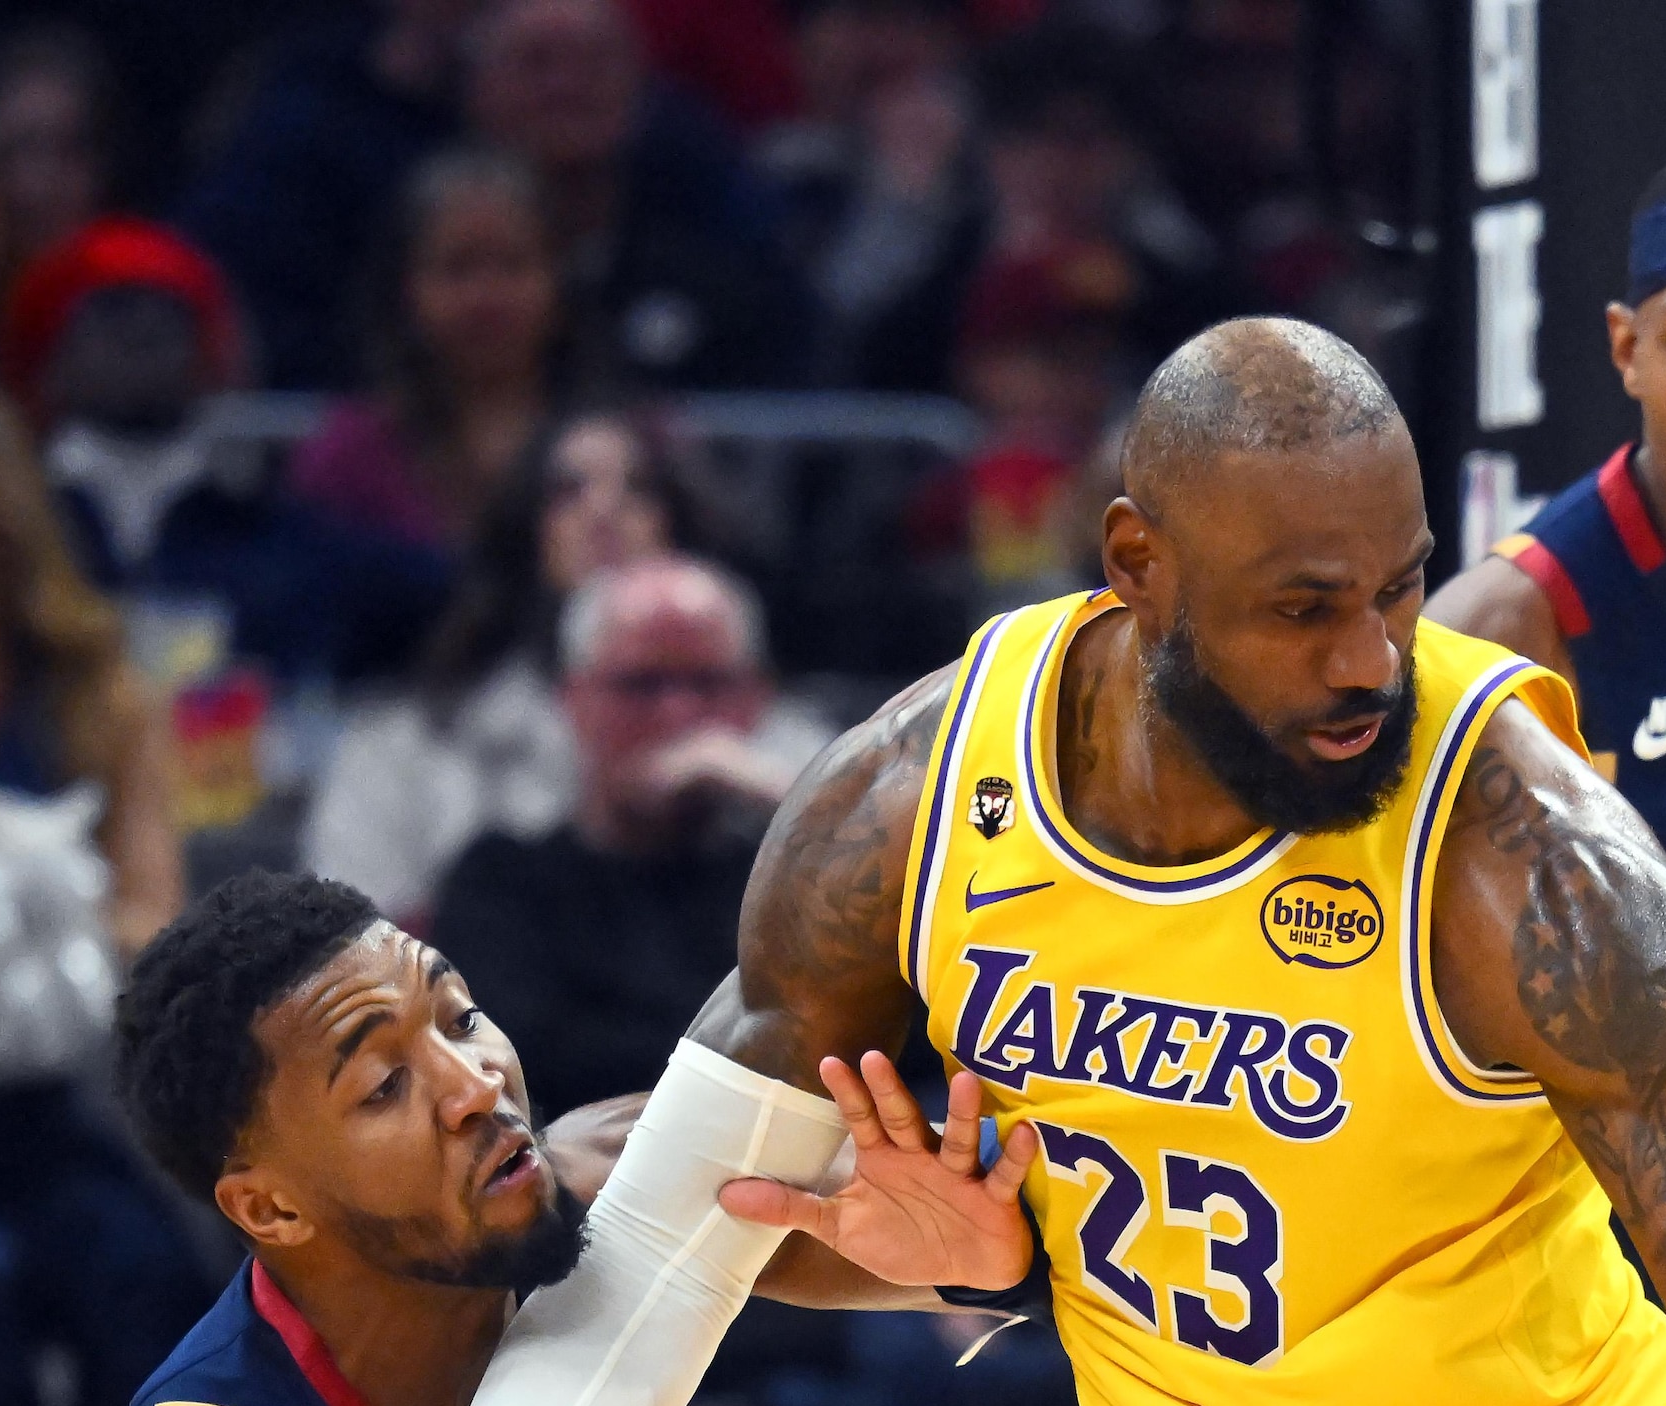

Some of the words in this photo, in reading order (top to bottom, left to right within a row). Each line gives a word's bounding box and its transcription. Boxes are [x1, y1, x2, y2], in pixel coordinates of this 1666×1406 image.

[1273, 897, 1376, 943] bibigo
[1289, 929, 1332, 948] 비비고
[950, 944, 1355, 1143] LAKERS
[1030, 1119, 1286, 1370] 23
